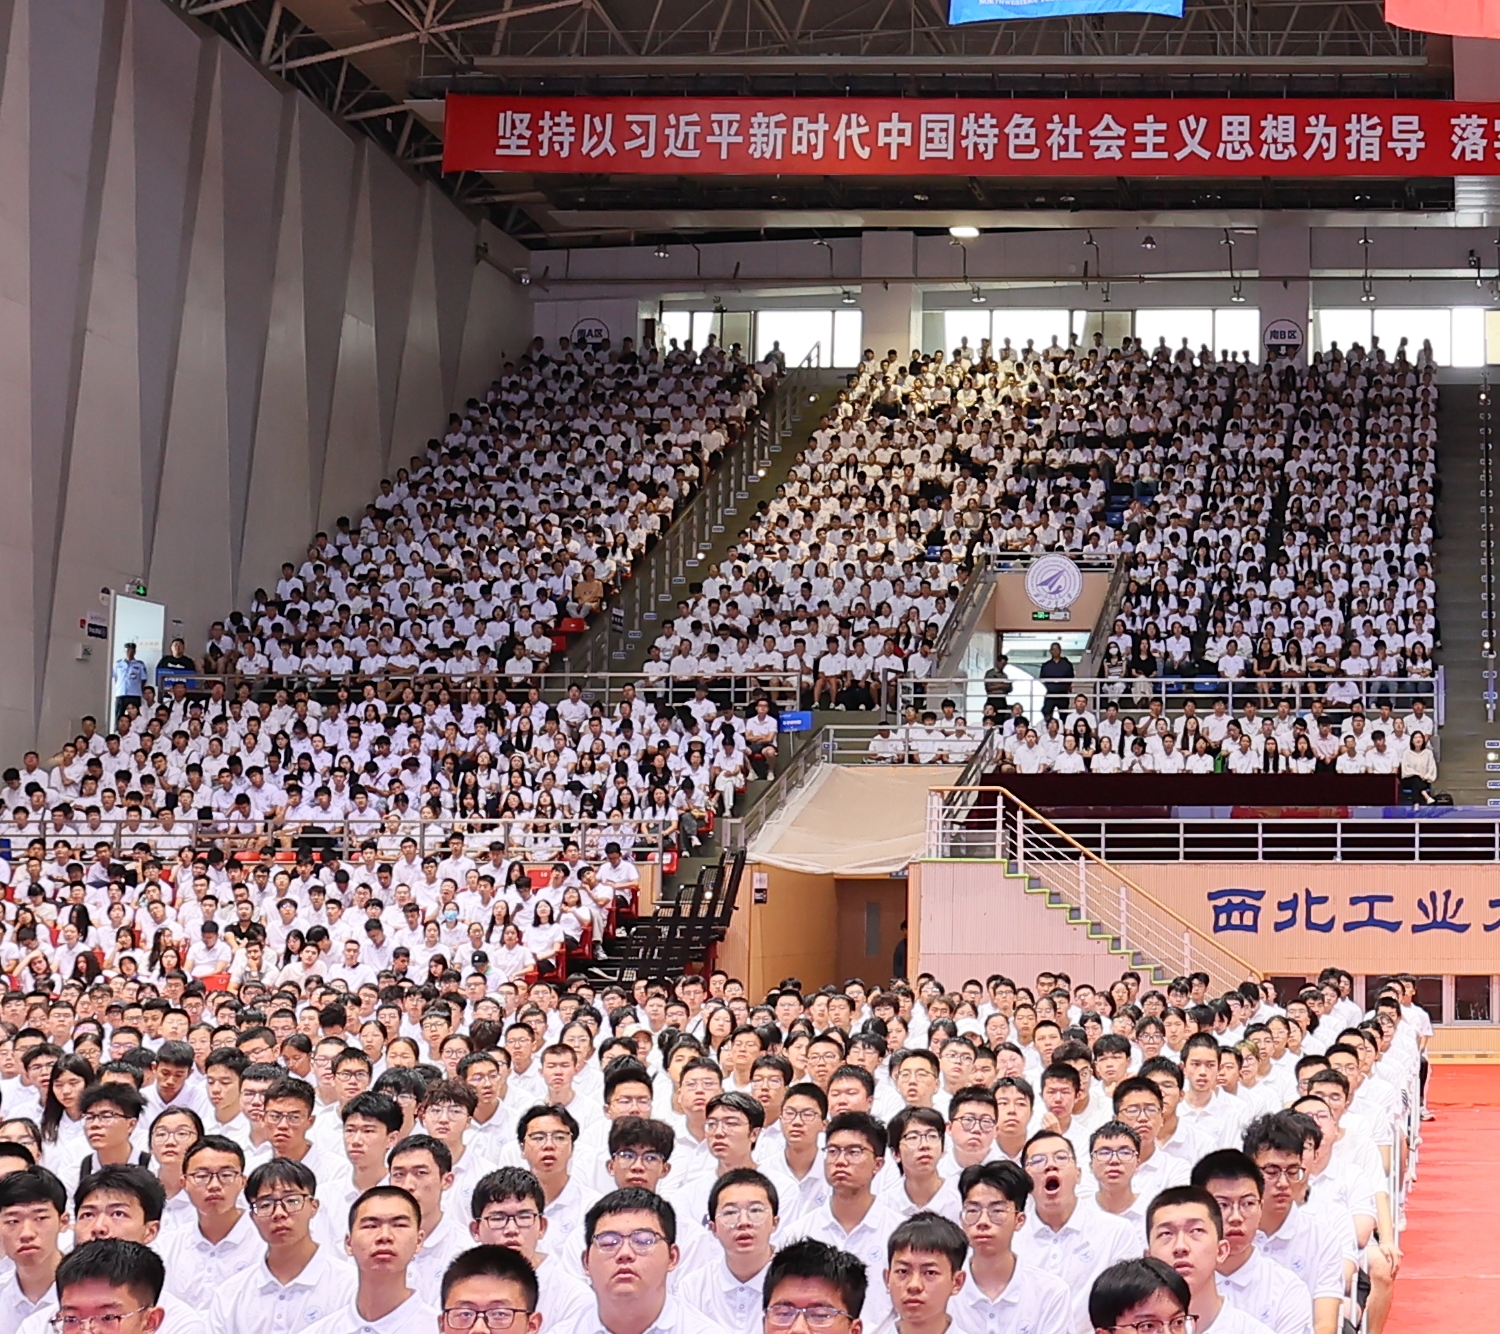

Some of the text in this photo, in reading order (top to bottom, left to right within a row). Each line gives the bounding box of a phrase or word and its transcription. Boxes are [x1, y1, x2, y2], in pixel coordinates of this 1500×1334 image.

[496, 111, 1425, 161] 坚持以习近平新时代中国特色社会主义思想为指导
